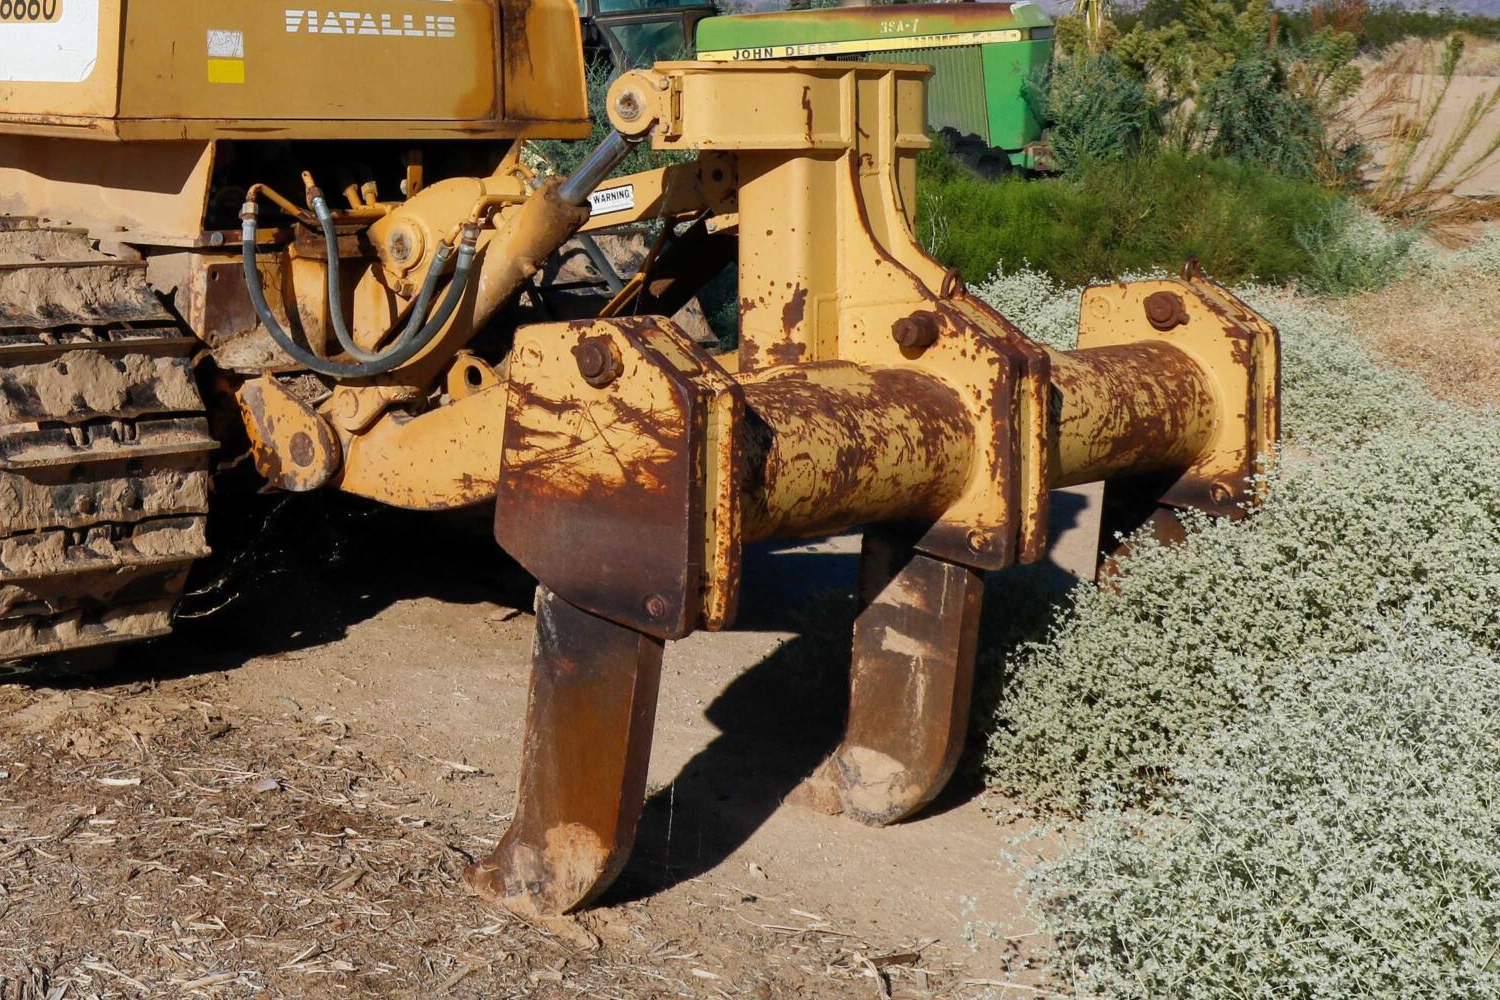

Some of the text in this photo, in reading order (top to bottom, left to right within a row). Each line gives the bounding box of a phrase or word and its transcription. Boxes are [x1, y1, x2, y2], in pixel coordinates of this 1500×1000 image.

[285, 9, 456, 38] FIATALLIS
[732, 41, 839, 60] JOHN DEE
[592, 189, 630, 204] WARNING
